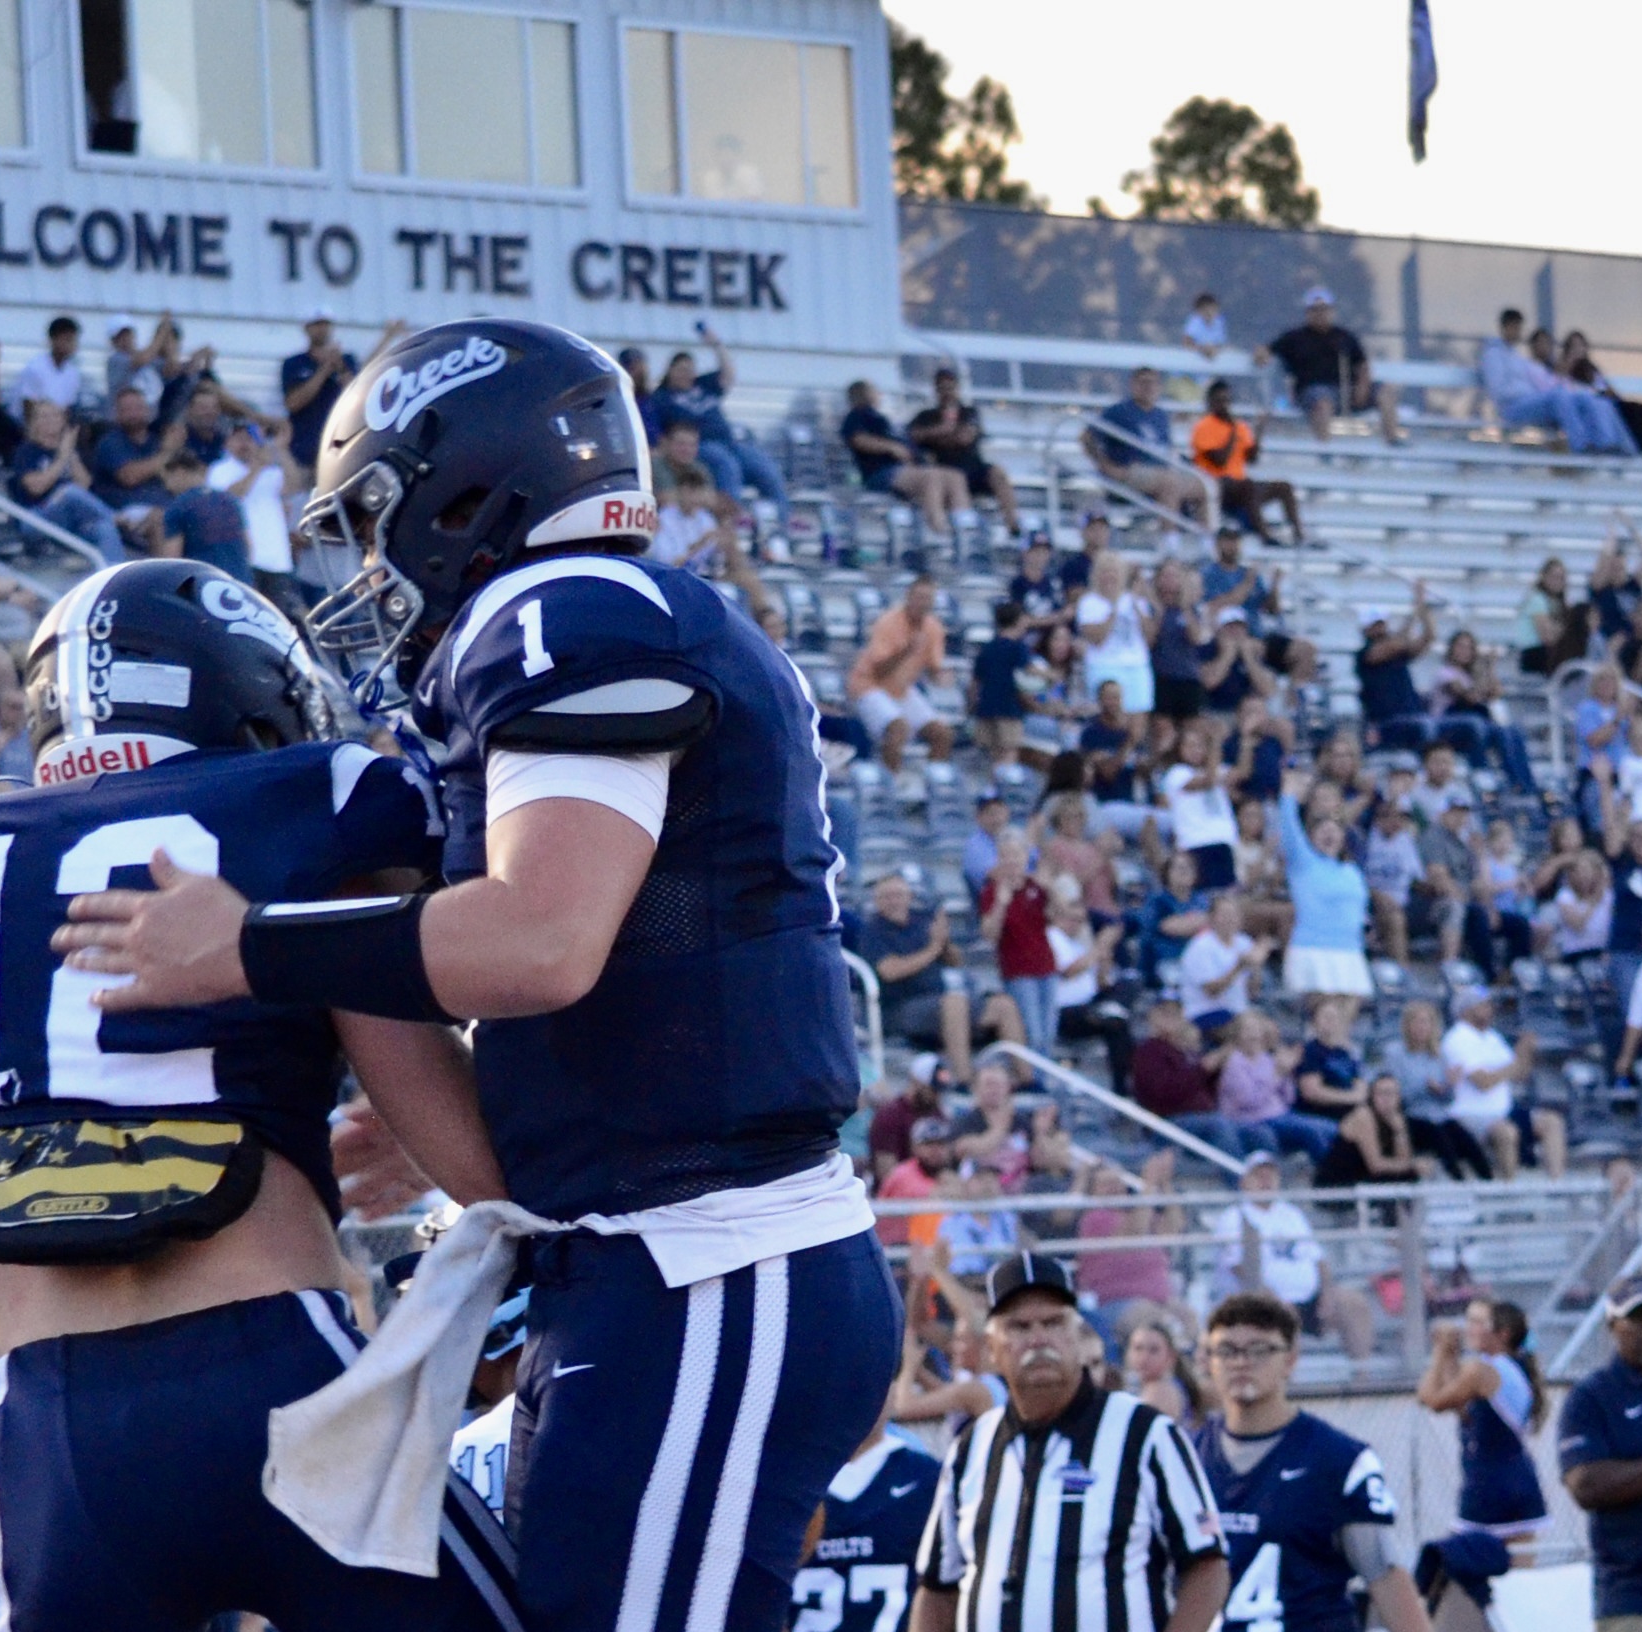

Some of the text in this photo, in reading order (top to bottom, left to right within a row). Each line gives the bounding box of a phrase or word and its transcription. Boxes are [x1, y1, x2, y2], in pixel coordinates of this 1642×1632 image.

[268, 218, 362, 288] TO
[395, 228, 533, 299] THE
[570, 240, 787, 312] CREEK
[364, 336, 508, 433] Creek
[517, 598, 556, 679] 1
[39, 740, 151, 785] Riddell
[816, 1535, 874, 1561] COLTS
